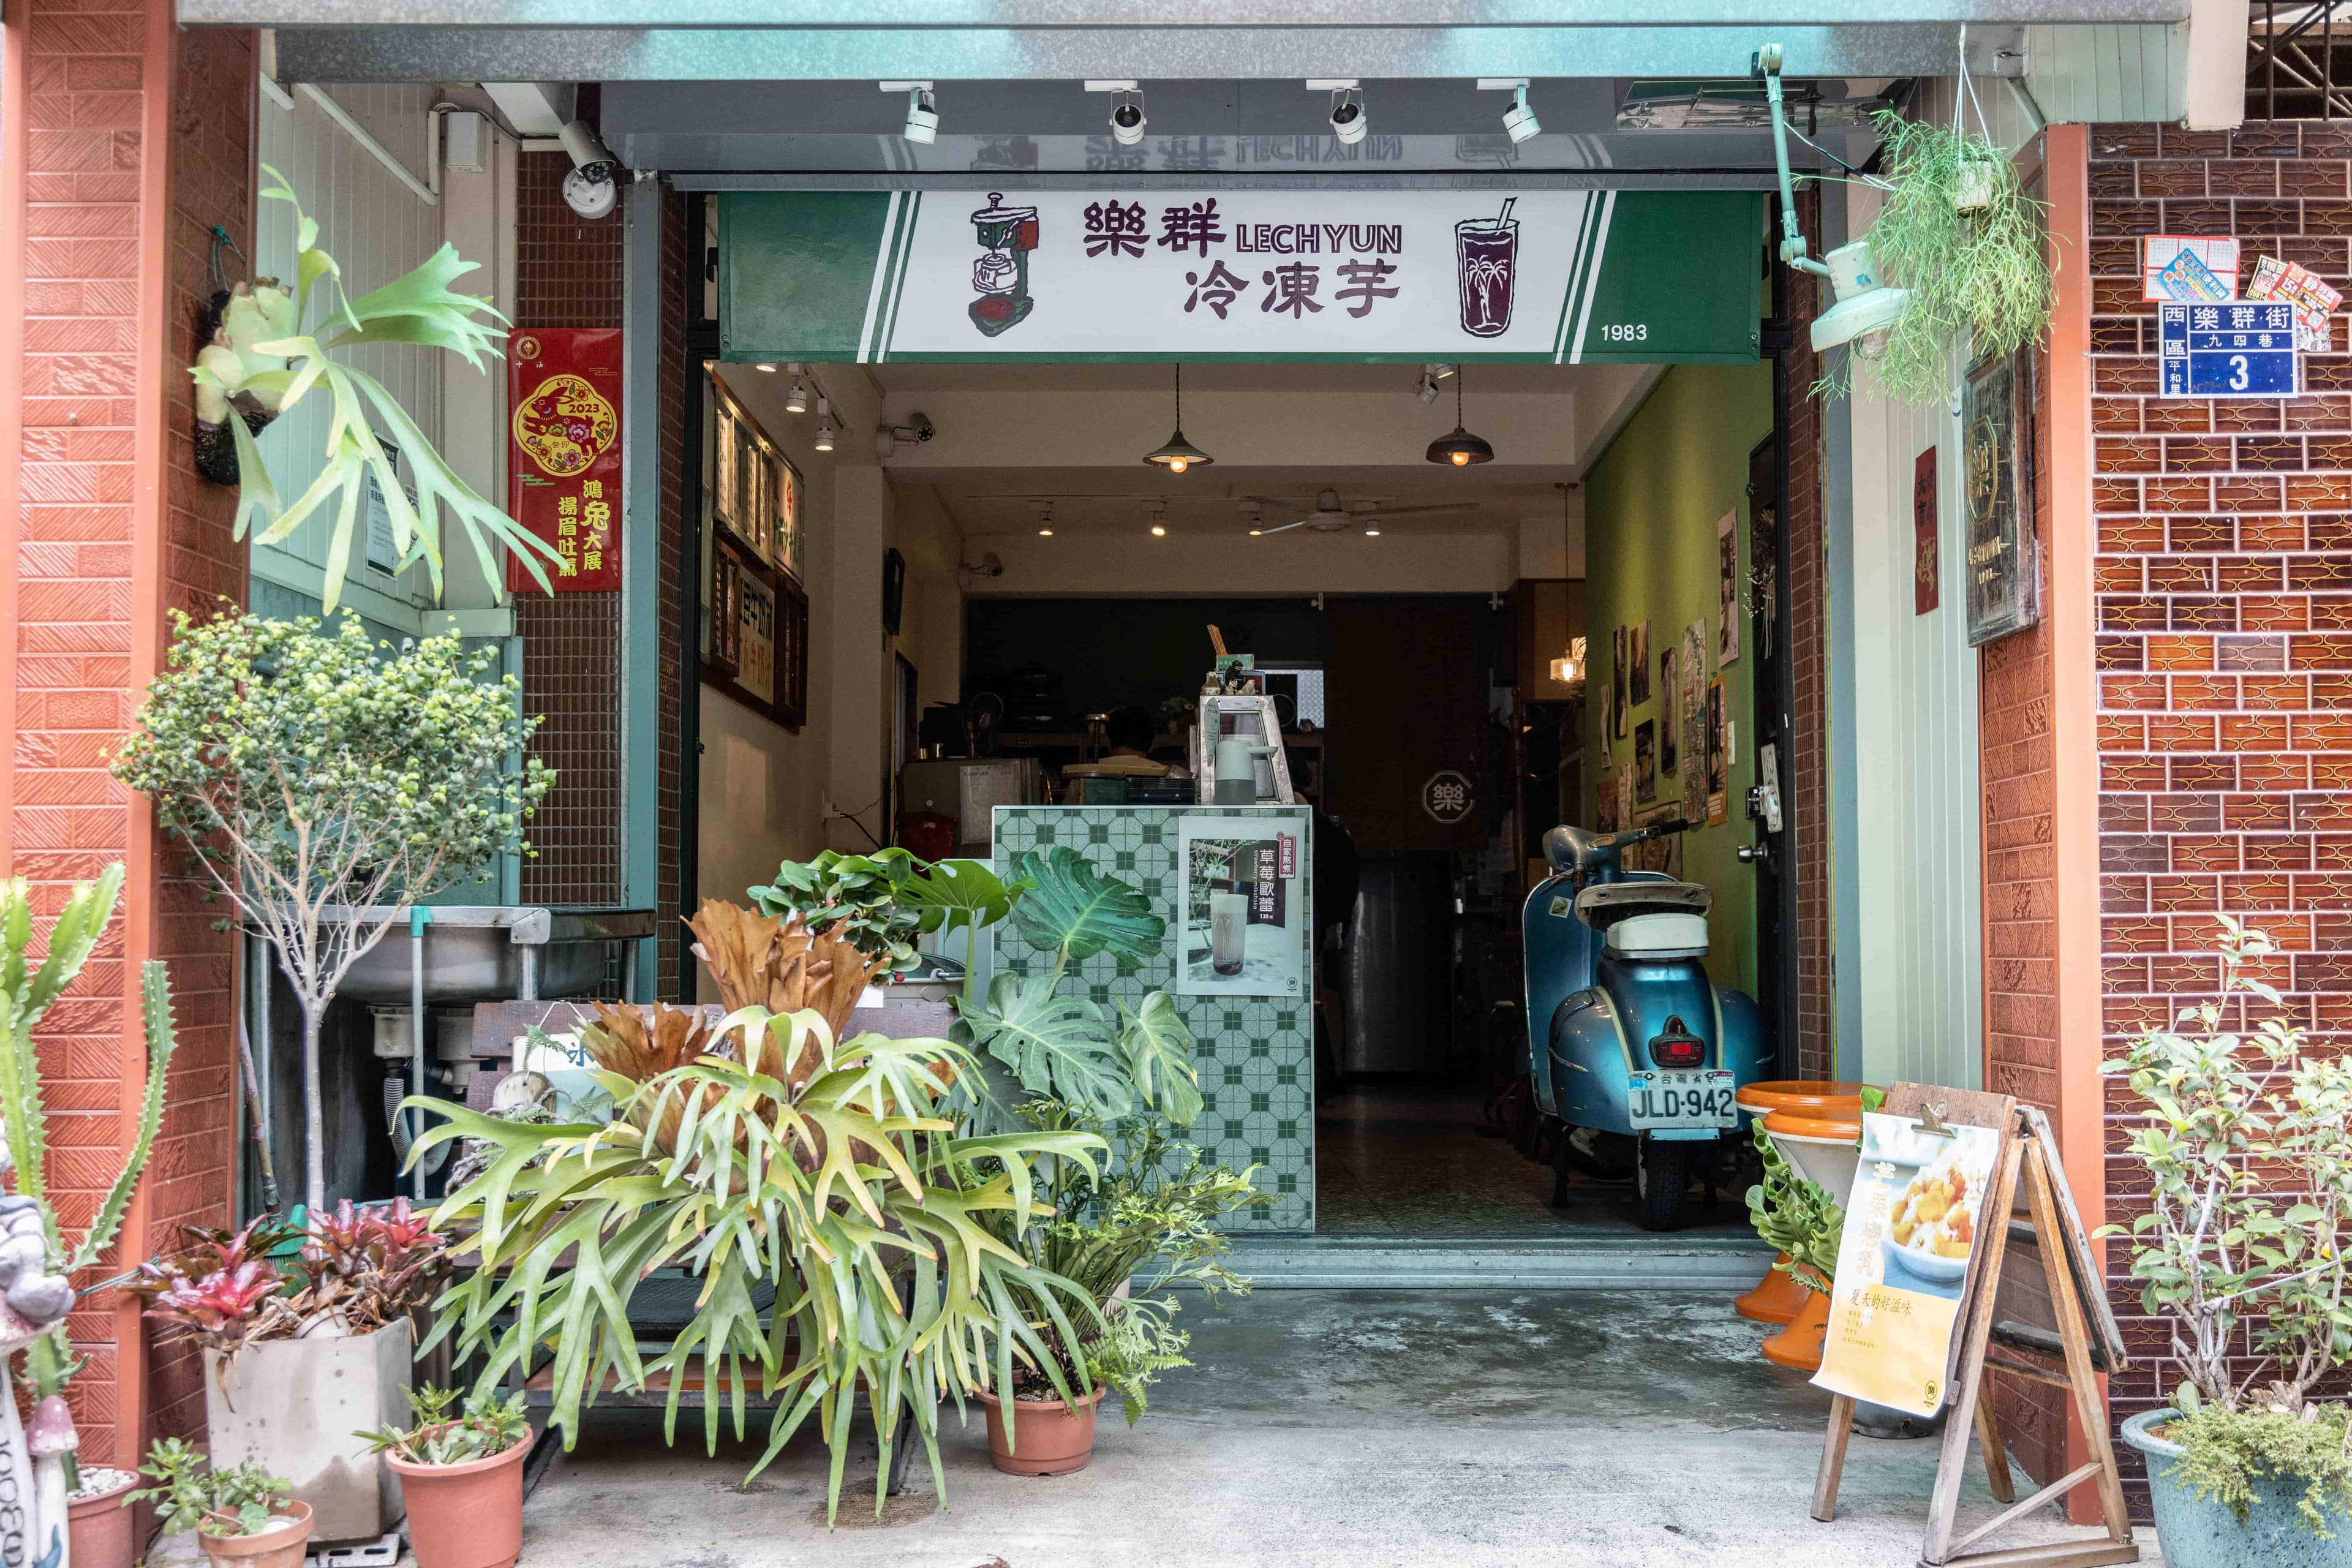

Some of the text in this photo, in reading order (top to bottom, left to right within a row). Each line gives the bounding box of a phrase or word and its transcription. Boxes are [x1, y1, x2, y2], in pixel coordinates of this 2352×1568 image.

[1083, 198, 1403, 258] 樂群 LECHYUN
[1183, 258, 1400, 320] 冷凍芋
[1600, 323, 1648, 341] 1983
[2165, 306, 2186, 356] 西區
[2194, 306, 2290, 330] 樂群街
[2209, 333, 2273, 347] 九四巷
[2168, 360, 2182, 394] 平和里
[2229, 355, 2248, 391] 3
[568, 403, 600, 414] 2023
[580, 479, 611, 571] 鴻兔大展
[1433, 783, 1464, 811] 樂
[1259, 849, 1275, 912] 草莓歐蕾
[1849, 1289, 1912, 1317] 夏天的好滋味
